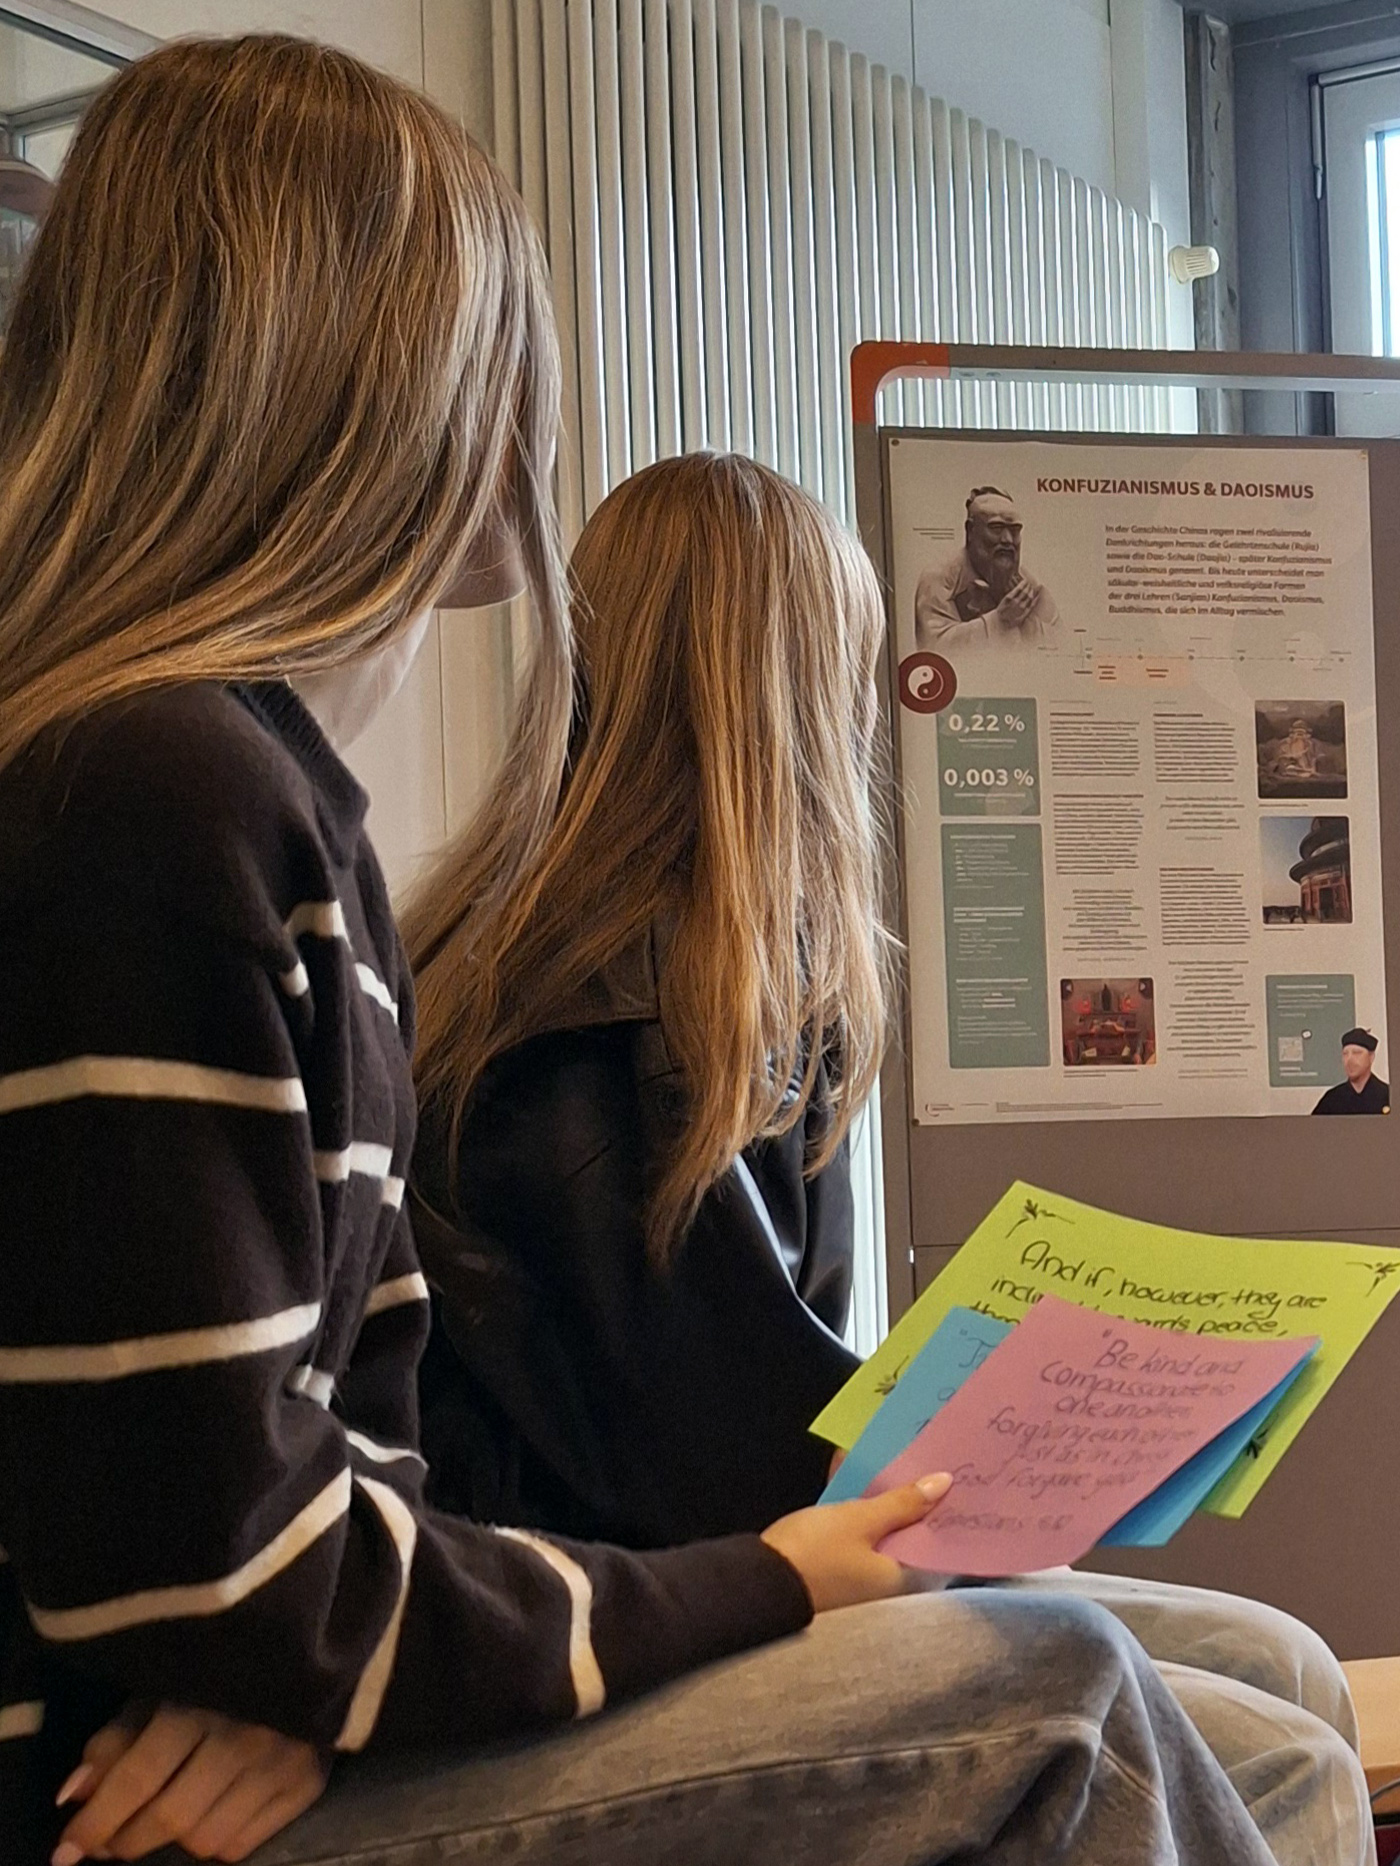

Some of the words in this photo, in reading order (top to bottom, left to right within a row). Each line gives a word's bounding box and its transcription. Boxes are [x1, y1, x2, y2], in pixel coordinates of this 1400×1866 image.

[1037, 478, 1200, 496] KONFUZIANISMUS
[1203, 481, 1217, 497] &
[1220, 482, 1315, 500] DAOISMUS
[948, 713, 1000, 734] 0,22
[1004, 714, 1025, 732] %
[944, 768, 1009, 788] 0,003
[1013, 768, 1035, 787] %
[1020, 1239, 1086, 1282] And
[1231, 1288, 1283, 1321] they
[1286, 1293, 1328, 1309] are
[1196, 1319, 1288, 1337] peace,
[1139, 1346, 1201, 1375] kind
[1195, 1357, 1245, 1376] and
